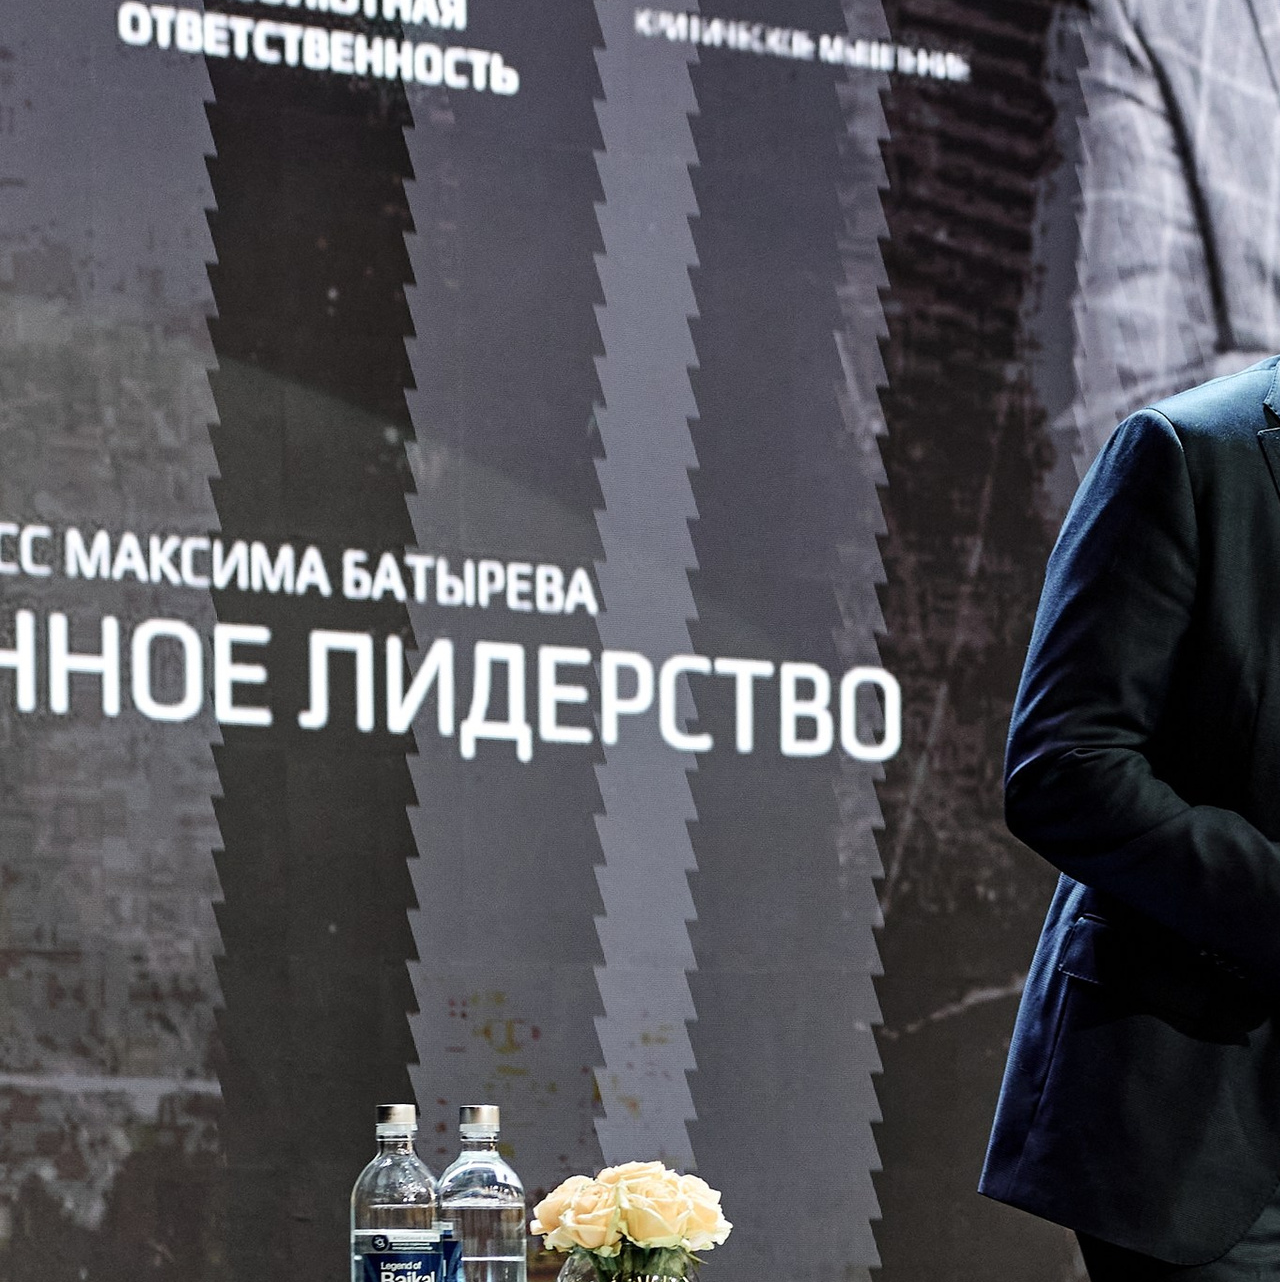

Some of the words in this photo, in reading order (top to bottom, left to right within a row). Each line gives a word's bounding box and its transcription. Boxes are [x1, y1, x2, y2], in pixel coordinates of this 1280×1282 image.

[116, 0, 522, 97] ОТВЕТСТВЕННОСТЬ
[65, 527, 330, 598] МАКСИМА
[341, 546, 599, 616] БАТЫРЕВА
[298, 627, 904, 763] ЛИДЕРСТВО
[380, 1261, 412, 1272] Legend
[413, 1260, 422, 1270] of
